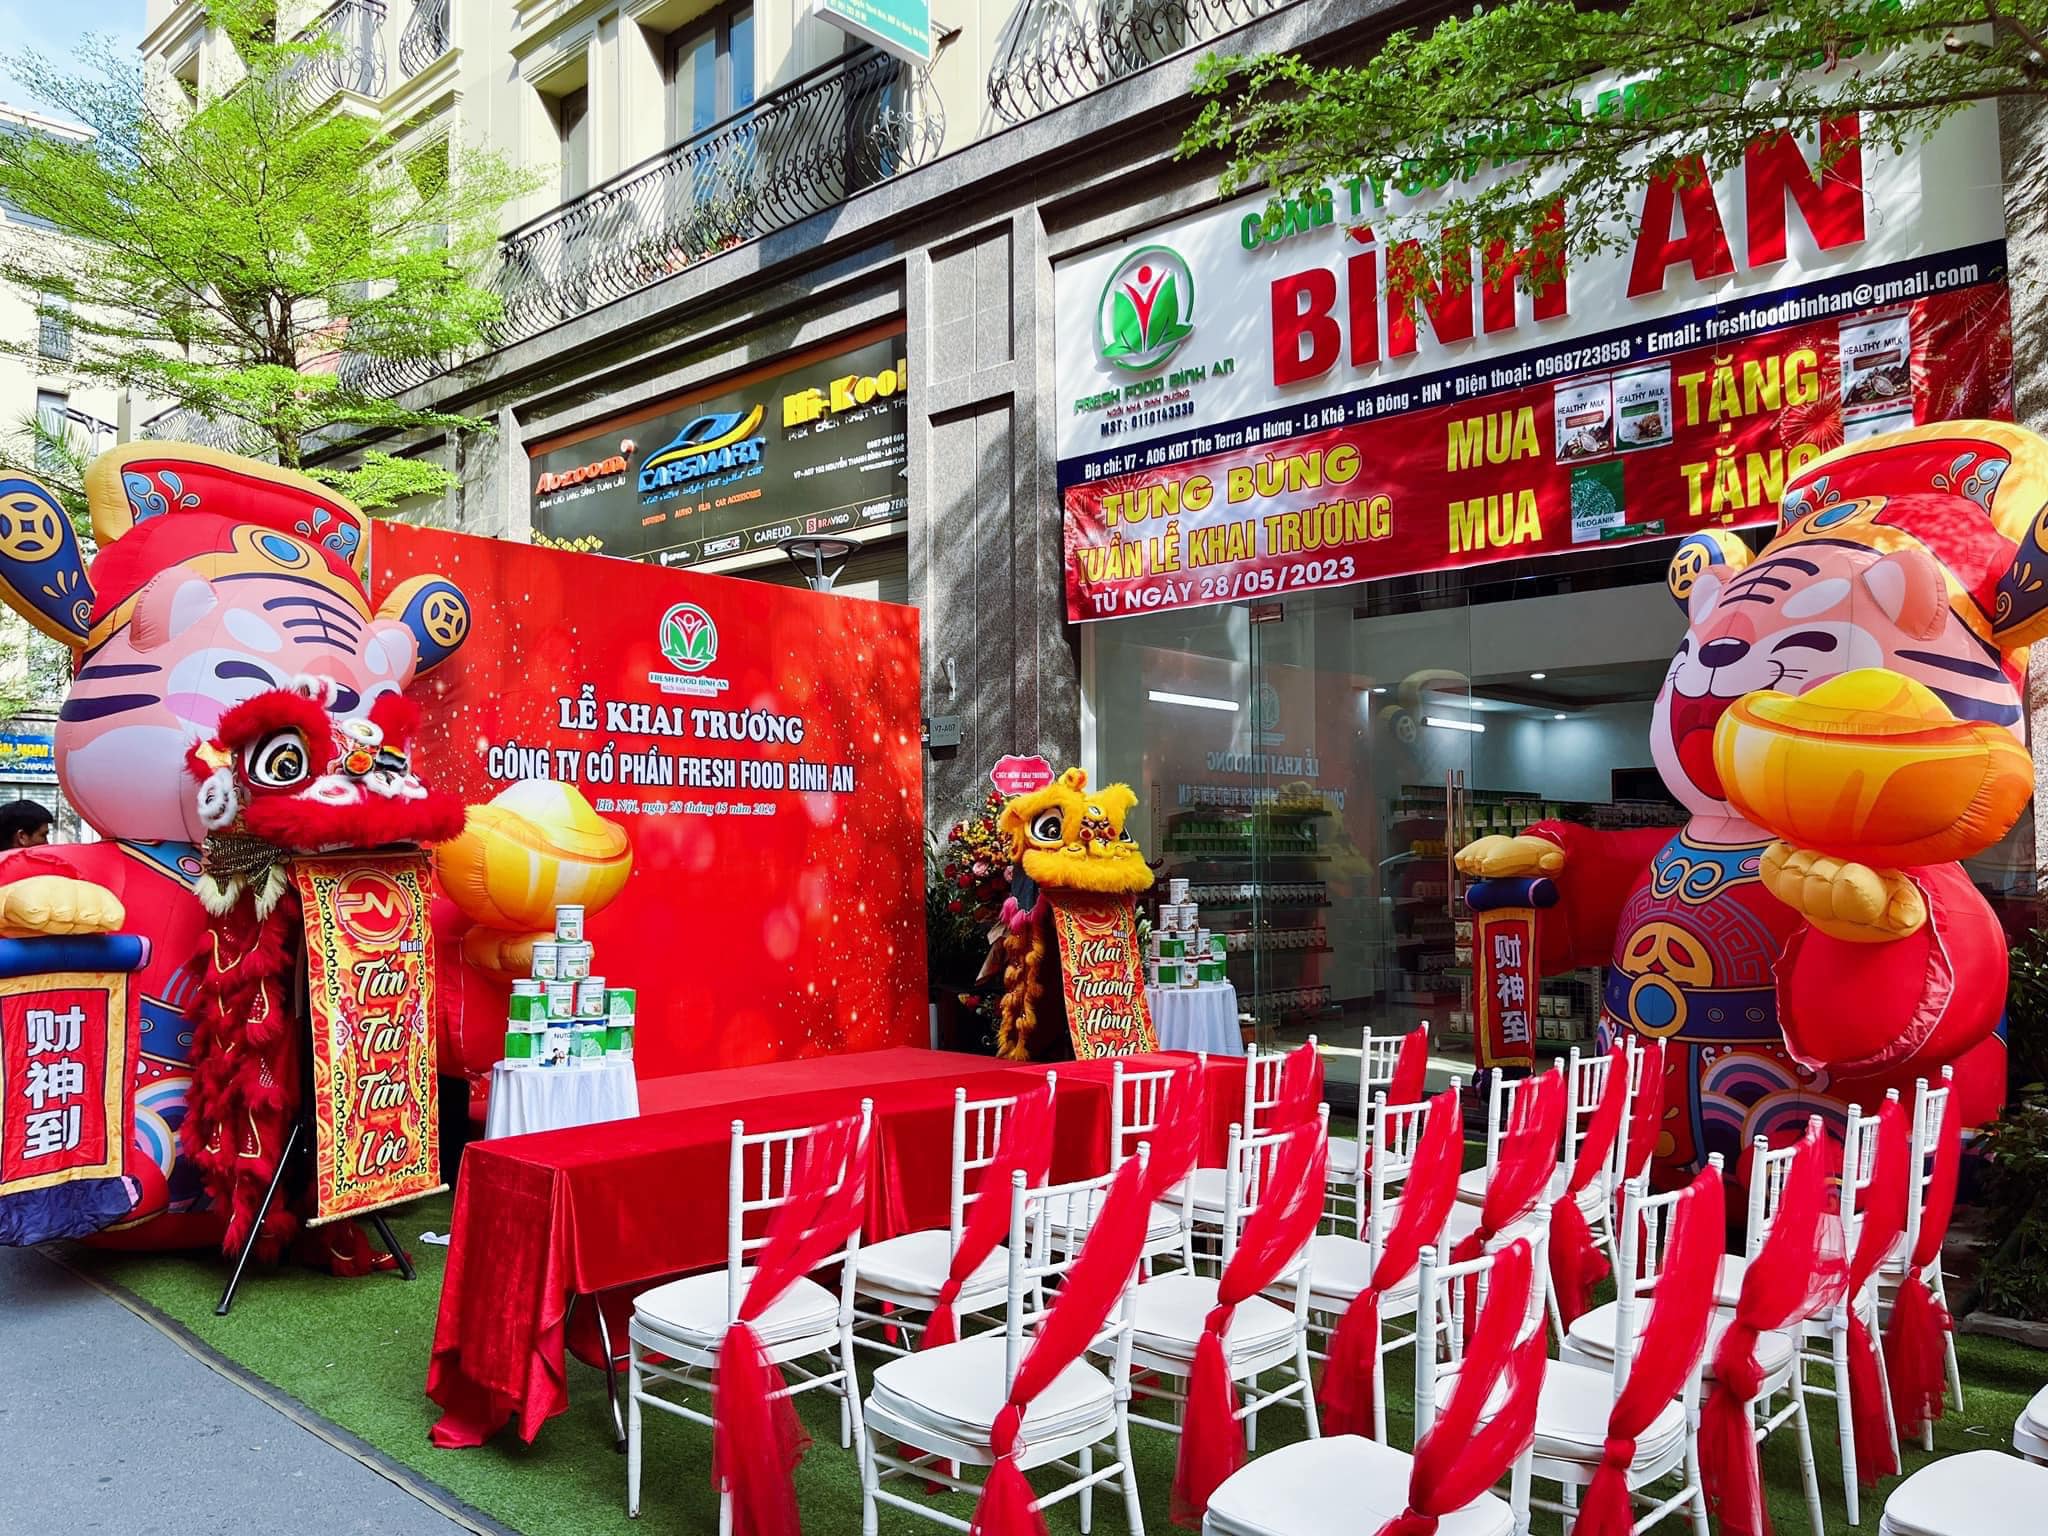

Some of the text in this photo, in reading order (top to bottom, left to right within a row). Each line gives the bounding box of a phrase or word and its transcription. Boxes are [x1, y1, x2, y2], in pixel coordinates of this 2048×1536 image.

[1271, 197, 1568, 387] BÌNH
[1627, 109, 1866, 298] AN
[1844, 337, 1903, 355] HEALTHY MILK
[1074, 358, 1235, 416] FRESH FOOD BÌNH AN
[1085, 462, 1101, 482] Địa
[1124, 455, 1136, 470] V7
[1146, 448, 1165, 466] A06
[1169, 441, 1189, 460] KĐT
[1192, 437, 1212, 456] The
[1215, 429, 1242, 450] Terra
[1245, 426, 1260, 443] An
[1263, 418, 1292, 441] Hưng
[1304, 412, 1318, 430] La
[1321, 404, 1345, 426] Khê
[1357, 398, 1373, 418] Hà
[1376, 391, 1409, 416] Đông
[1422, 383, 1442, 404] HN
[1455, 370, 1487, 396] Điện
[1491, 363, 1532, 390] thoại:
[1535, 340, 1631, 379] 0968723858
[1647, 323, 1701, 354] Email:
[1706, 262, 1979, 339] freshfoodbinhan@gmail.com
[1648, 387, 1665, 399] MILK
[1447, 347, 1819, 473] MUA TẶNG
[1558, 402, 1587, 415] HEALTHY
[1228, 443, 1362, 504] BỪNG
[754, 525, 792, 543] CAREUD
[818, 514, 849, 529] BRAVIGO
[1076, 494, 1392, 585] TUẦN LỄ KHAI TRƯƠNG
[1448, 488, 1543, 554] MUA
[1576, 515, 1615, 529] NEOGANIK
[1092, 555, 1356, 613] TỪ NGÀY 28/05/2023
[675, 677, 697, 685] FOOD
[558, 684, 804, 744] LỄ KHAI TRƯƠNG
[488, 740, 854, 793] CÔNG TY CỔ PHẦN FRESH FOOD BÌNH AN
[669, 801, 681, 814] 28
[1081, 939, 1122, 967] Khai
[354, 954, 408, 1004] Tấn
[1072, 973, 1135, 1005] Trương
[1494, 934, 1530, 1044] 财神到
[1086, 1003, 1134, 1038] Hồng
[23, 1005, 86, 1160] 财神到
[357, 1068, 409, 1119] Tấn
[357, 1130, 409, 1178] Lộc
